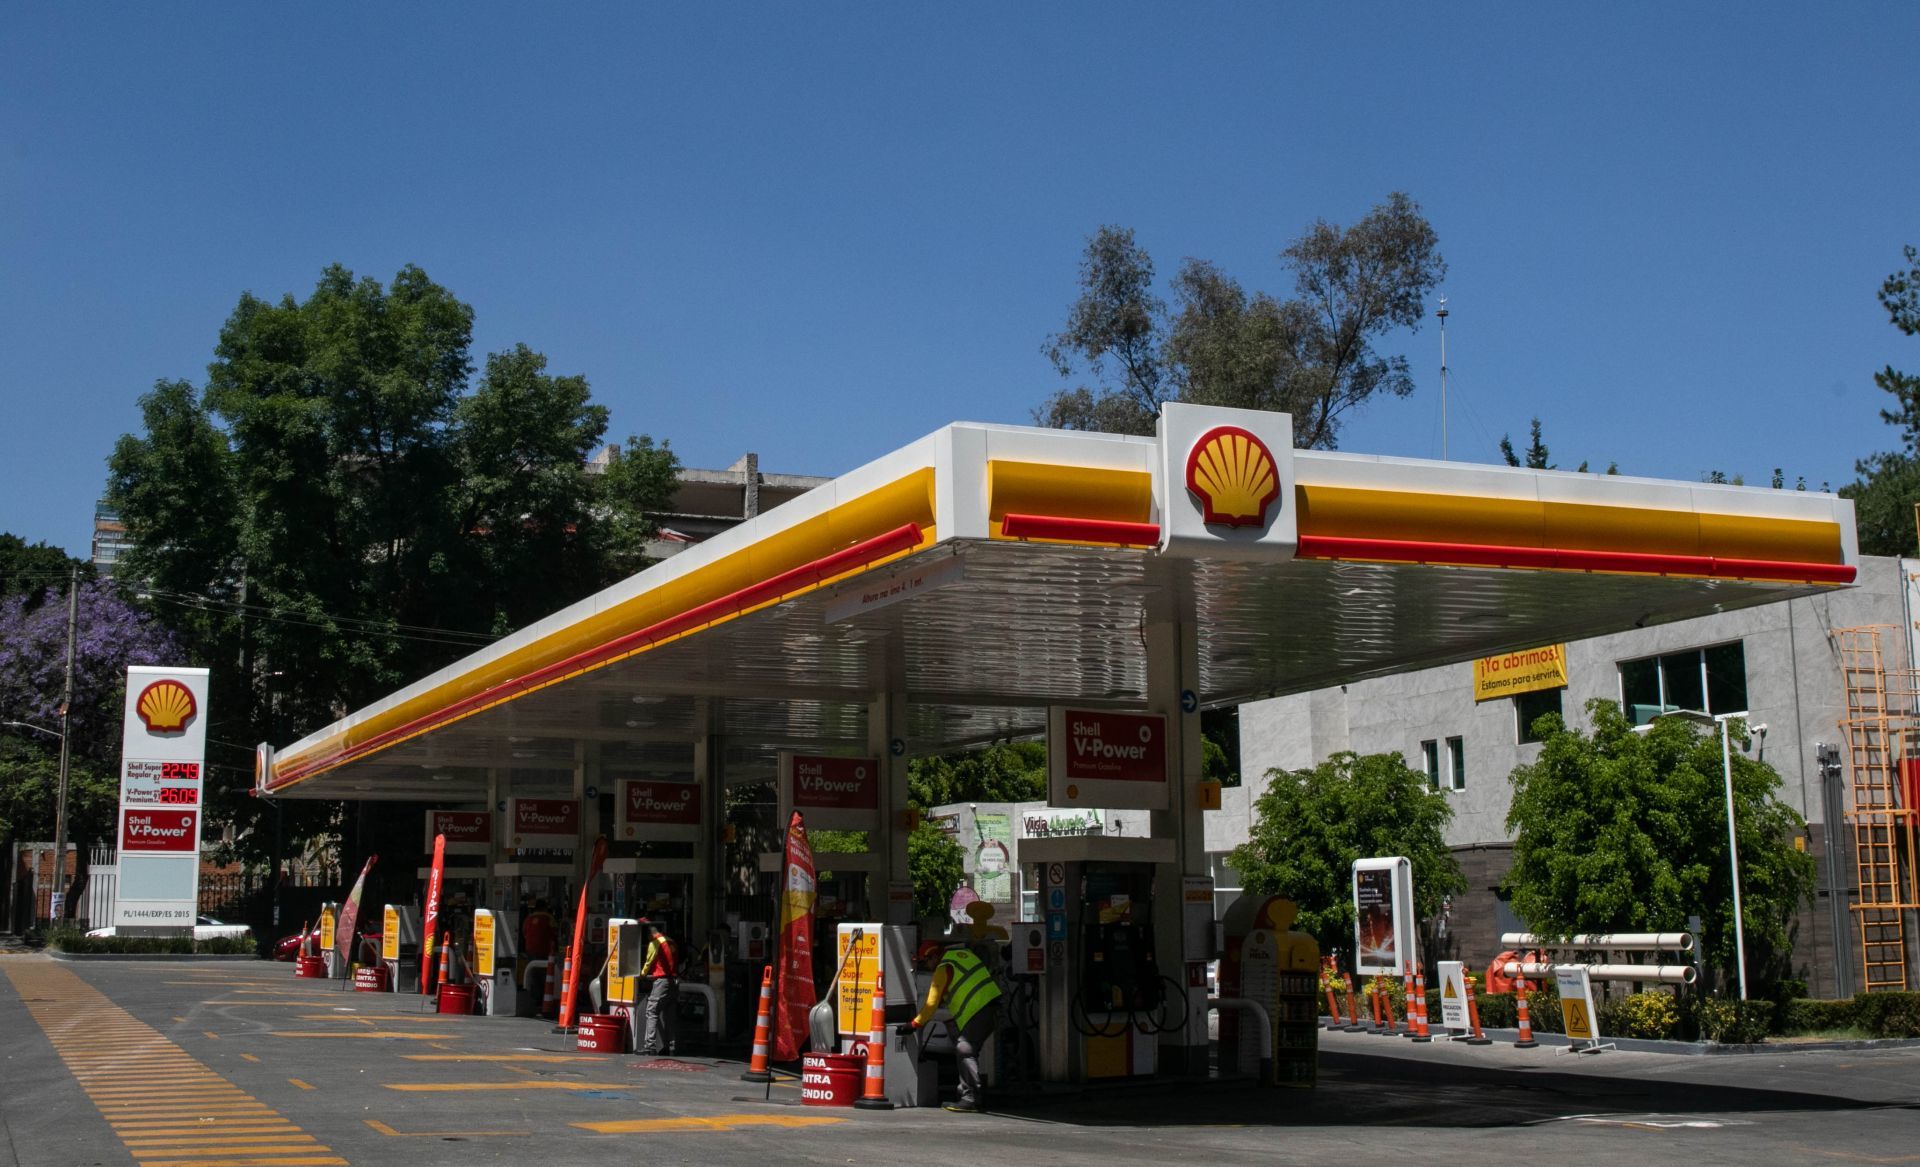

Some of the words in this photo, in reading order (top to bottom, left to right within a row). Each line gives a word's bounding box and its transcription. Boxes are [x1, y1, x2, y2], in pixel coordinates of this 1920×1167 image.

[1504, 644, 1558, 670] abrimos!
[1482, 678, 1510, 690] Estamos
[1512, 674, 1530, 688] para
[1532, 668, 1560, 682] servirte
[1072, 721, 1100, 736] Shell
[1073, 737, 1146, 759] V-Power
[144, 764, 161, 772] Super
[161, 764, 199, 779] 22.49
[799, 764, 822, 776] Shell
[800, 776, 861, 792] V-Power
[160, 789, 197, 804] 26.09
[632, 787, 652, 797] Shell
[520, 803, 537, 812] Shell
[632, 798, 686, 811] V-Power
[129, 816, 151, 824] Shell
[520, 813, 566, 824] V-Power
[1024, 816, 1048, 831] Vida
[129, 825, 186, 836] V-Power
[843, 969, 863, 980] Super
